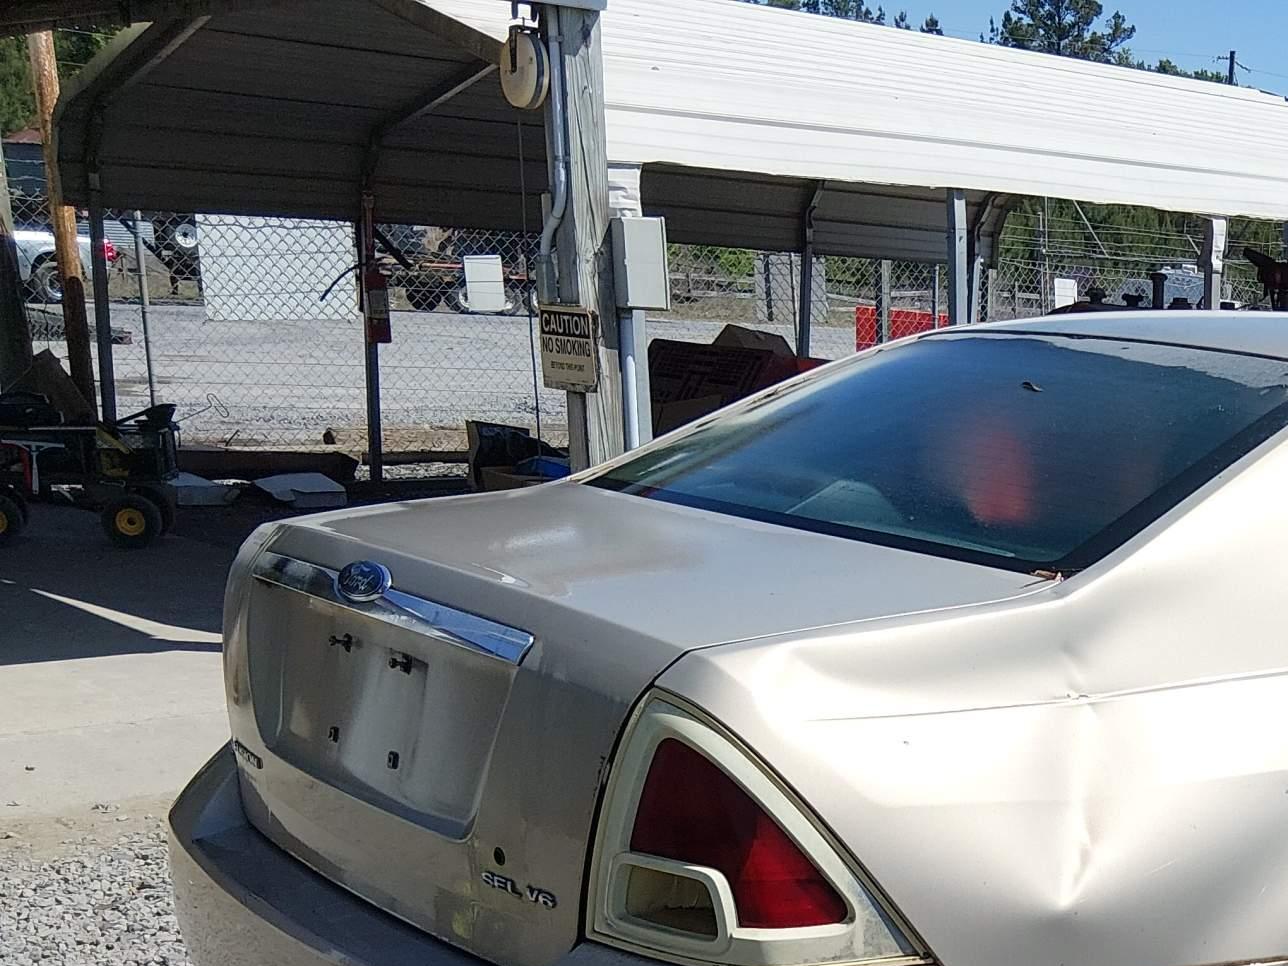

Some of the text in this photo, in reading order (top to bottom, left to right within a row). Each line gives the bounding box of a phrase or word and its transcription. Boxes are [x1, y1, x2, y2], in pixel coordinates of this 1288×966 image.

[542, 313, 589, 336] CAUTION
[543, 336, 591, 357] NO SMOKING
[481, 871, 557, 910] SEL V6
